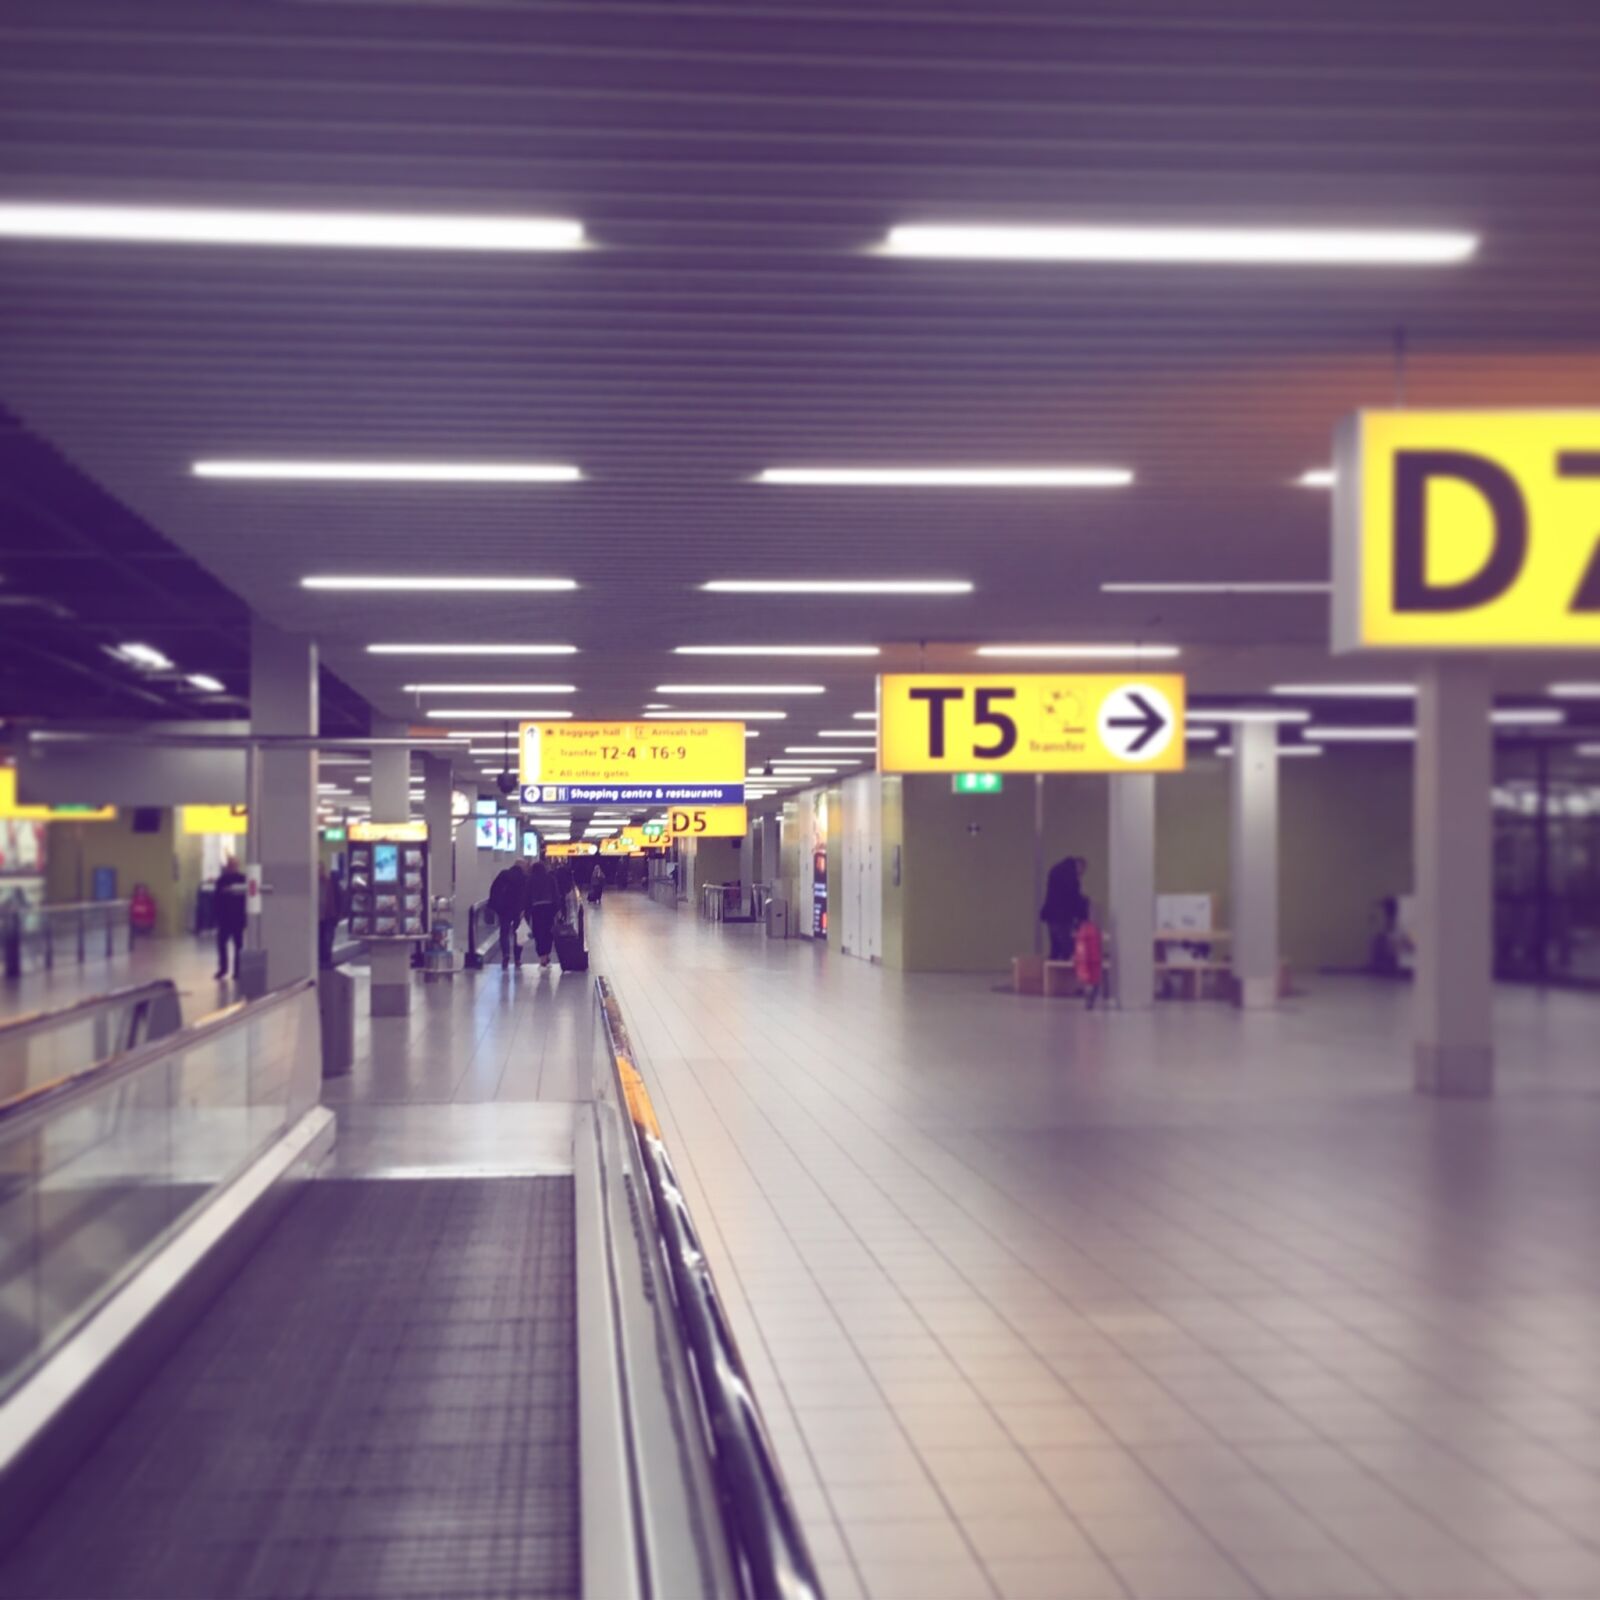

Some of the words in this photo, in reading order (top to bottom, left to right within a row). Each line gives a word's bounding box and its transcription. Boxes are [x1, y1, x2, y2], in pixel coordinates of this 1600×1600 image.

[908, 687, 1018, 759] T5
[559, 729, 600, 738] Baggage
[603, 728, 621, 736] hall
[651, 728, 688, 736] Arrivals
[690, 728, 708, 736] hall
[1029, 739, 1086, 752] Transfer
[560, 749, 597, 757] Transfer
[600, 746, 637, 760] T2-4
[650, 746, 687, 760] T6-9
[559, 769, 572, 777] All
[575, 769, 600, 777] other
[603, 770, 629, 779] gates
[570, 788, 619, 801] Shopping
[620, 789, 653, 799] centre
[655, 788, 664, 799] &
[665, 789, 723, 799] restaurants
[672, 811, 707, 832] D5
